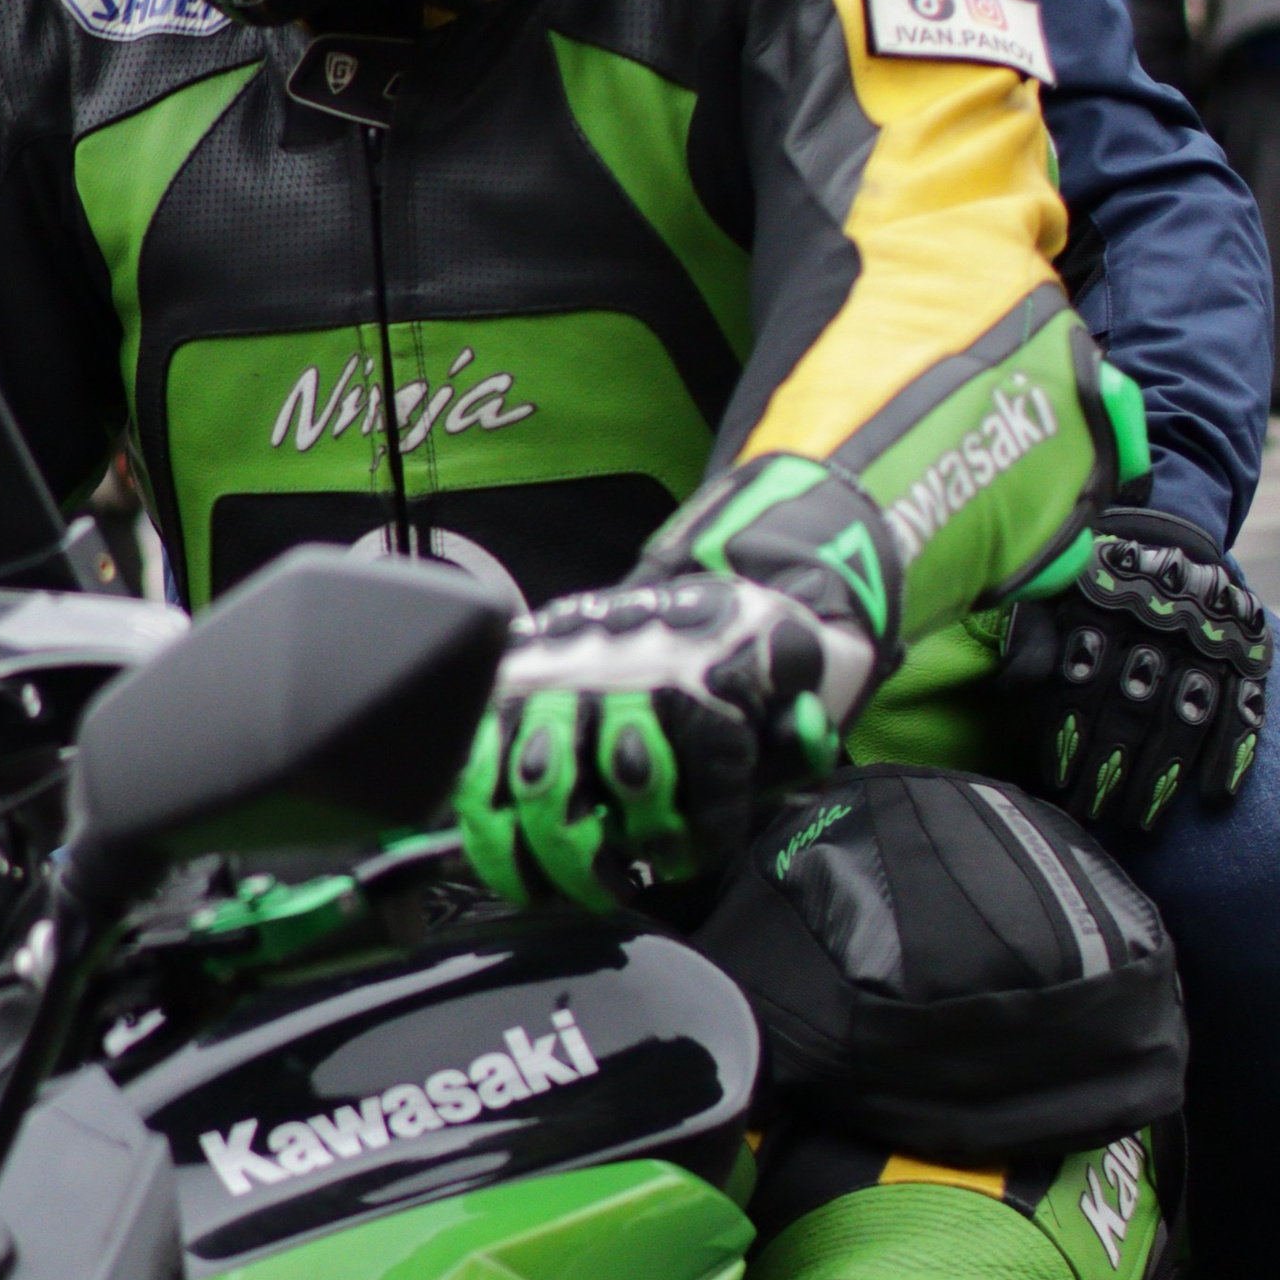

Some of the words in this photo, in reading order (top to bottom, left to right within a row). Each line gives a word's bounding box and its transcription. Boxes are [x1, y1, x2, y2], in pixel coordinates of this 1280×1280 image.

[271, 345, 536, 472] Ninja
[776, 803, 852, 881] Ninja
[199, 1009, 599, 1196] Kawasaki
